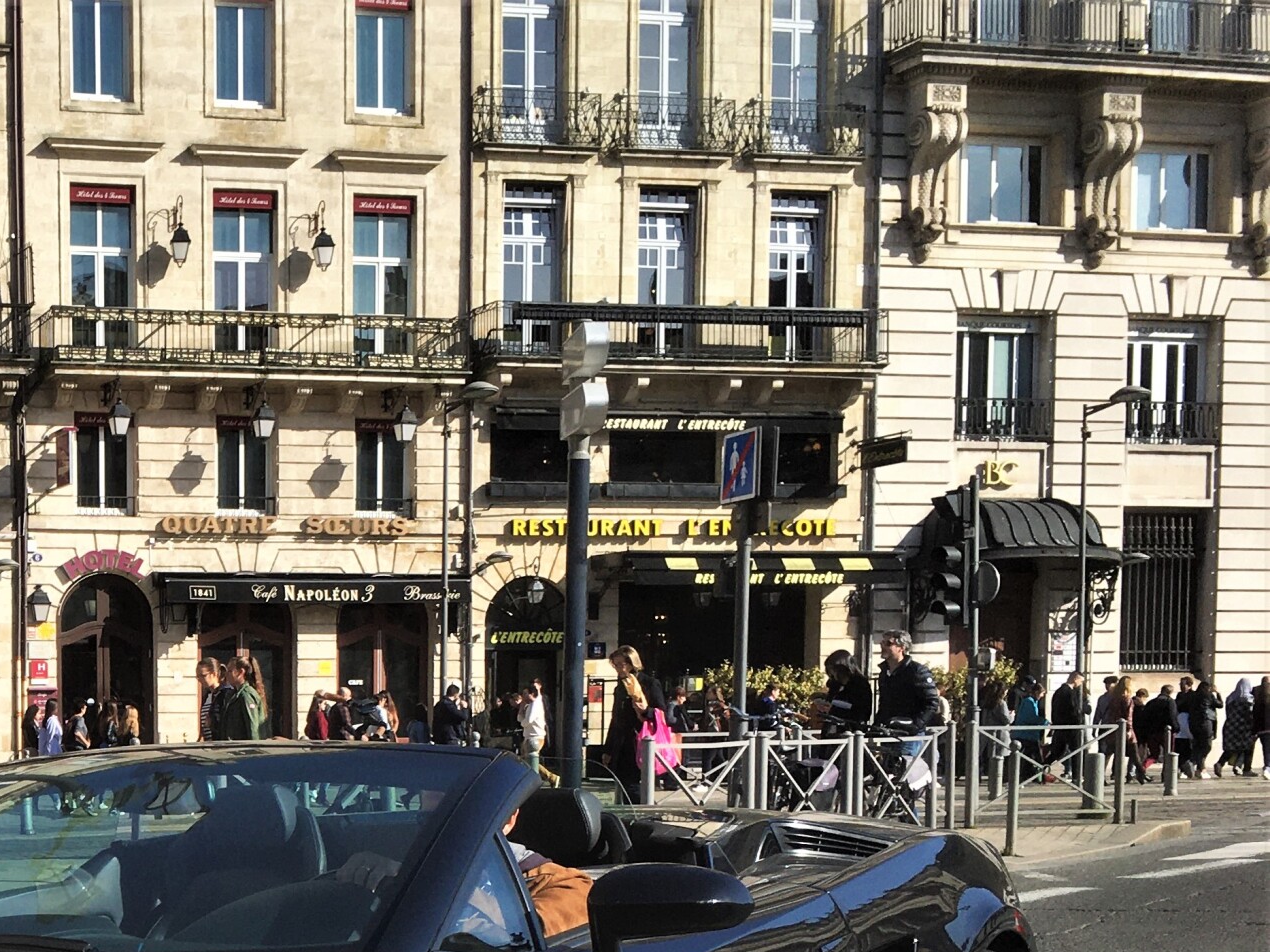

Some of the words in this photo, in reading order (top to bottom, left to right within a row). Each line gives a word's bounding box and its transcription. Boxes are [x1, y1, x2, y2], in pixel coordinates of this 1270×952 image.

[162, 515, 277, 535] QUATRE
[513, 519, 663, 536] RESTURANT
[63, 549, 145, 582] HOTEL
[193, 588, 213, 597] 1841
[251, 585, 277, 600] Café
[361, 585, 376, 602] 3
[403, 585, 461, 600] Brassie
[37, 663, 46, 671] H
